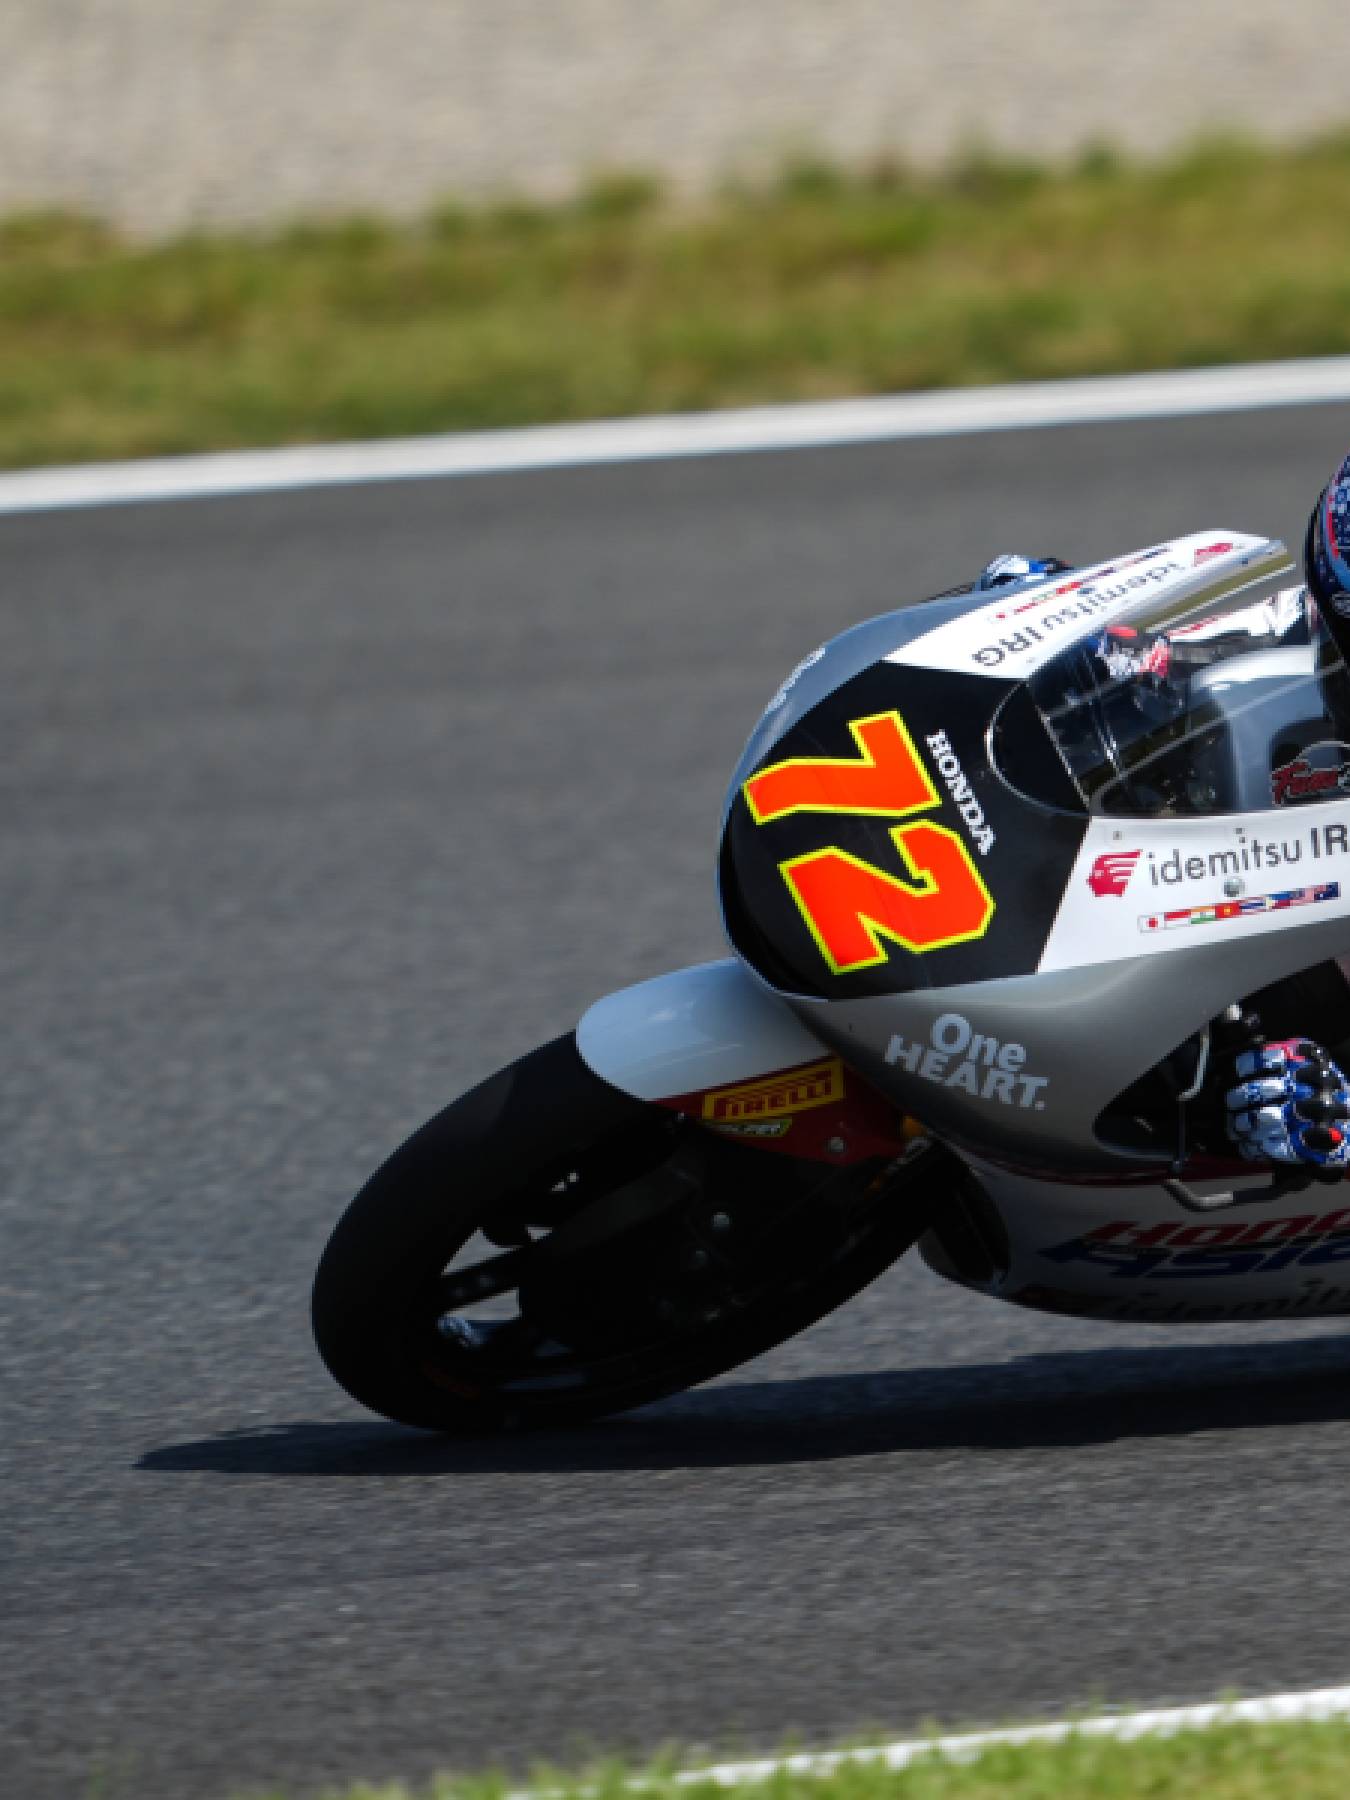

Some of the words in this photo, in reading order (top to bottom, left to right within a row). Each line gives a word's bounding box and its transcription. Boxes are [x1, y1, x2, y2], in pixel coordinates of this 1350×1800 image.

[971, 626, 1047, 669] IRG
[925, 729, 997, 855] HONDA
[743, 709, 997, 975] 72
[1147, 836, 1301, 887] idemitsu
[931, 1012, 1028, 1073] One
[712, 1066, 834, 1120] PIRELLI
